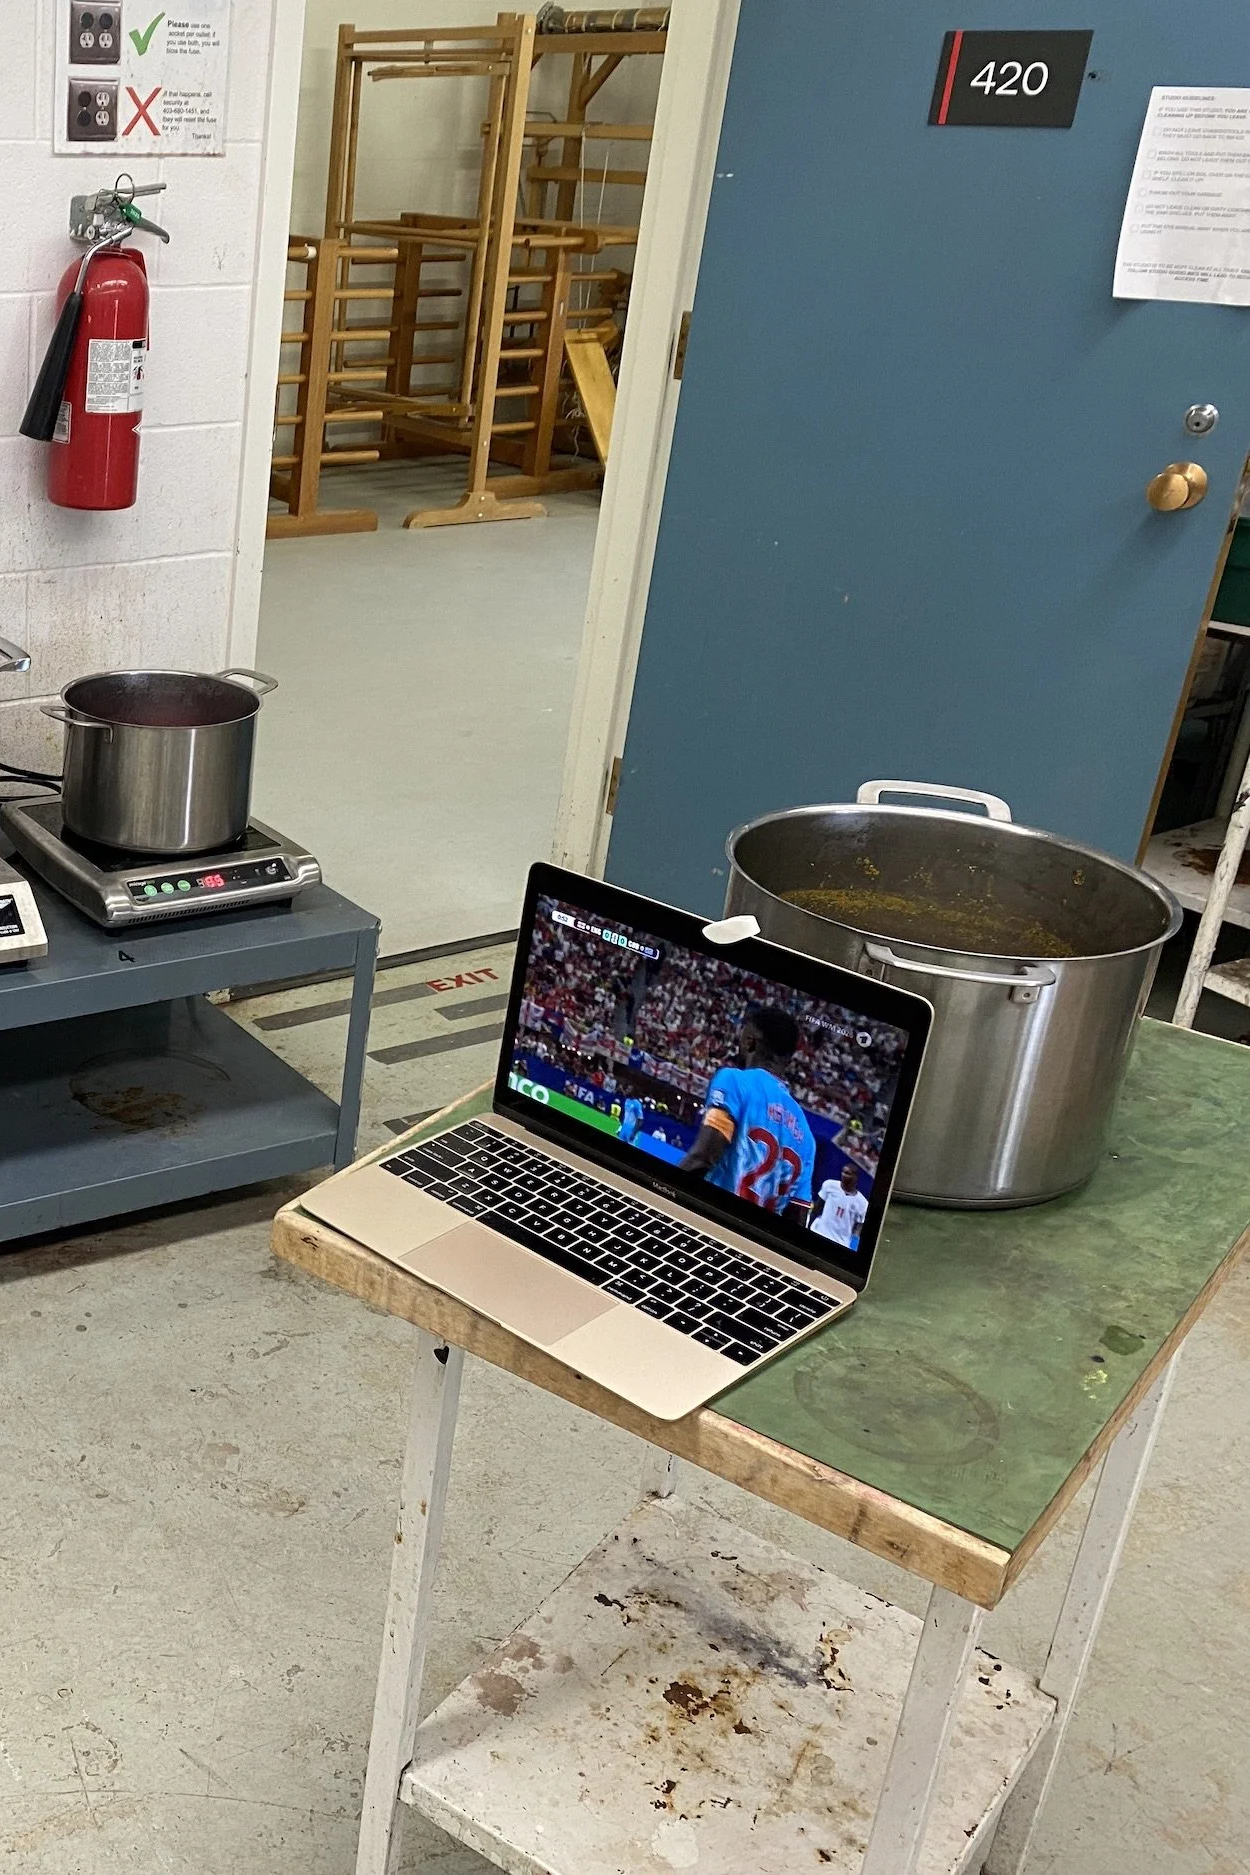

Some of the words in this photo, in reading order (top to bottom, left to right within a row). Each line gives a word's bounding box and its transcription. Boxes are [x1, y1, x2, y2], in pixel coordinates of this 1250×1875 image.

[167, 20, 189, 28] Please
[970, 61, 1049, 96] 420
[118, 950, 136, 963] 4
[428, 968, 499, 992] EXIT
[805, 1015, 821, 1026] FIFA
[821, 1020, 837, 1032] WM
[652, 1181, 676, 1198] MacBook
